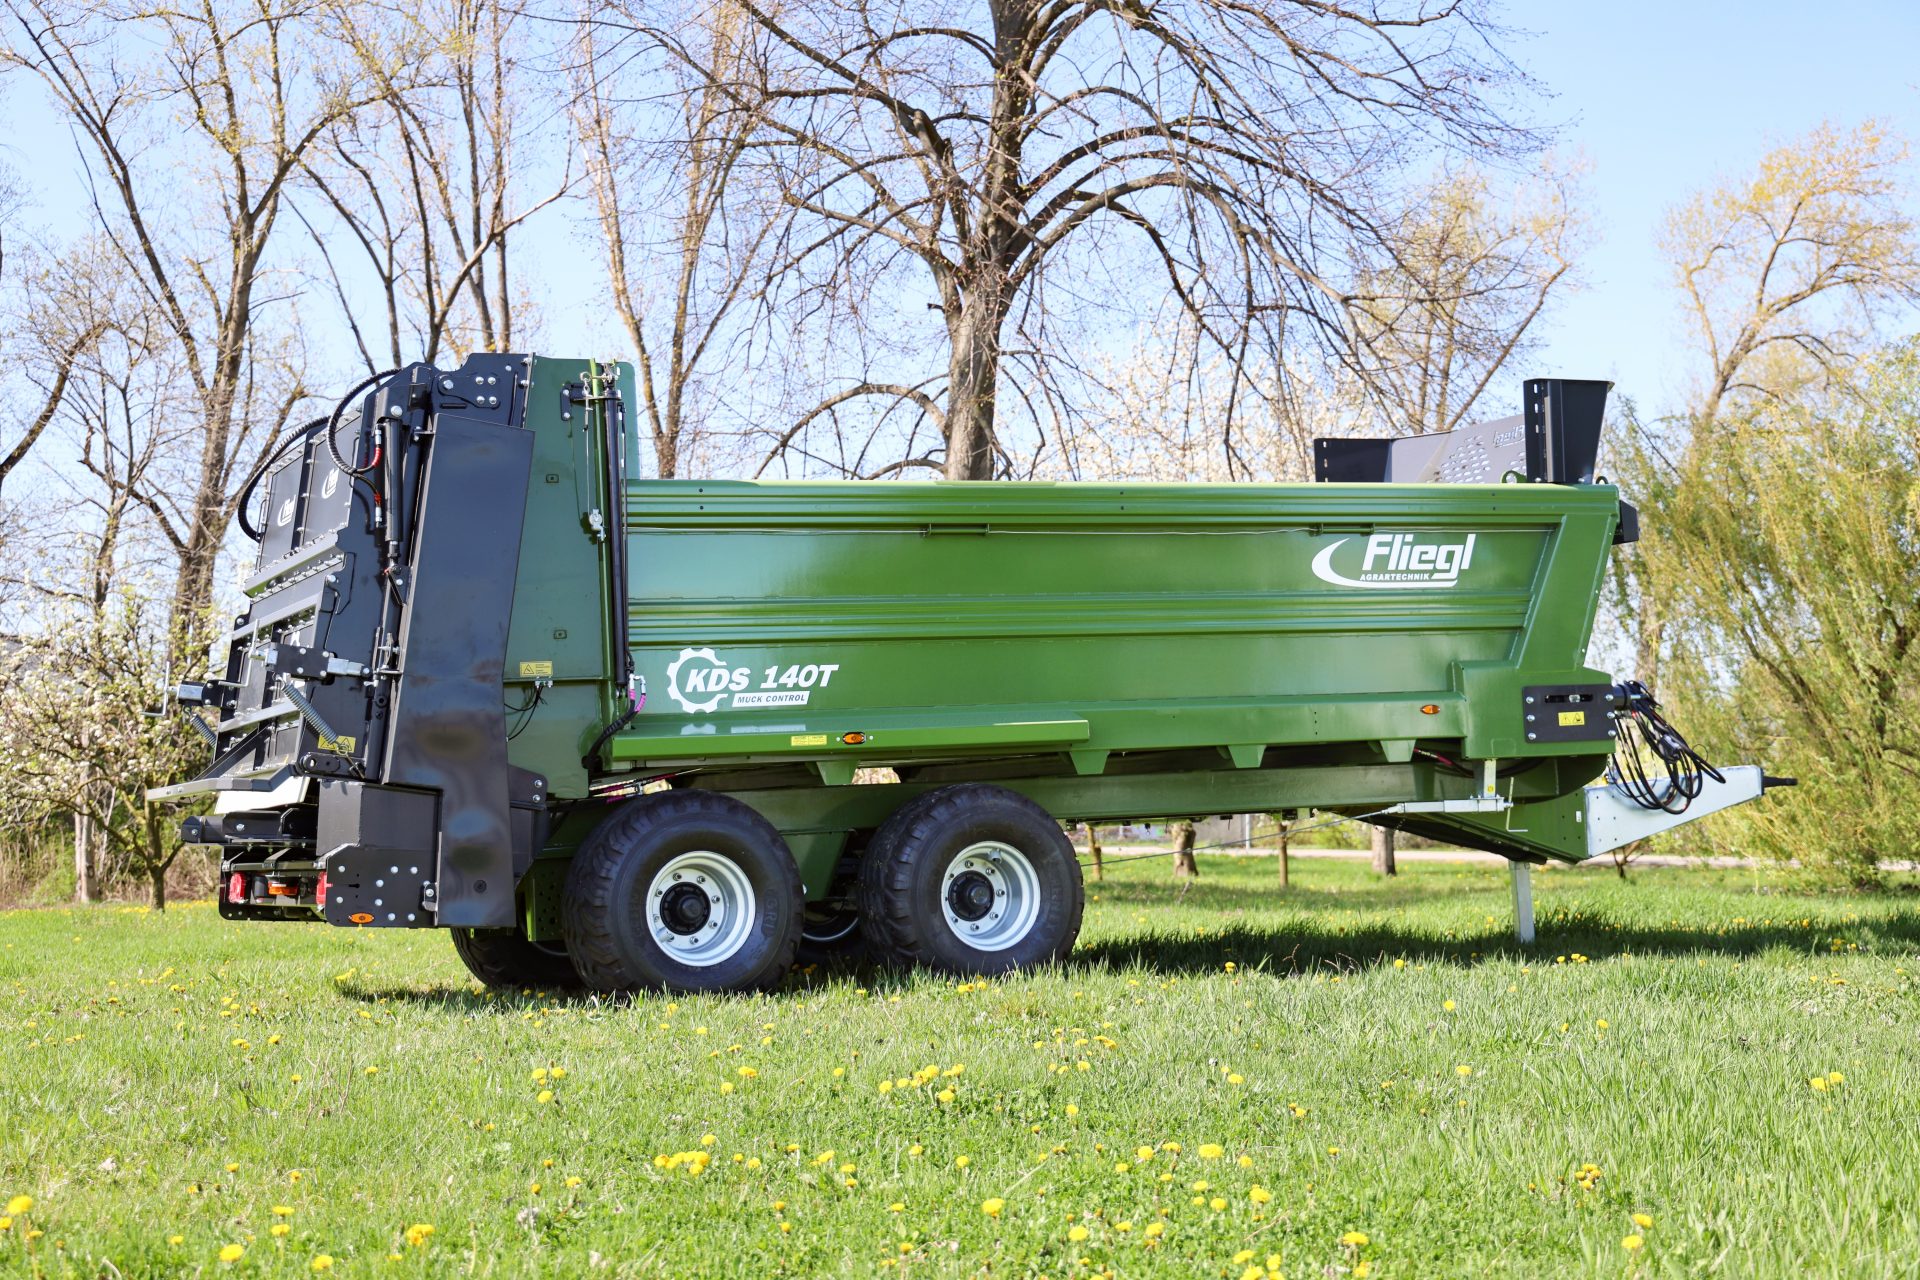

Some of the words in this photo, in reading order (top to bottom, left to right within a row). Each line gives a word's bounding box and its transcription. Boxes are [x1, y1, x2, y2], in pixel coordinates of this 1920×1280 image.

[1362, 533, 1477, 580] Fliegl
[1359, 572, 1430, 581] AGRARTECHNIK
[685, 667, 751, 692] KDS
[760, 664, 839, 689] 140T
[737, 695, 763, 704] MUCK
[765, 694, 805, 703] CONTROL
